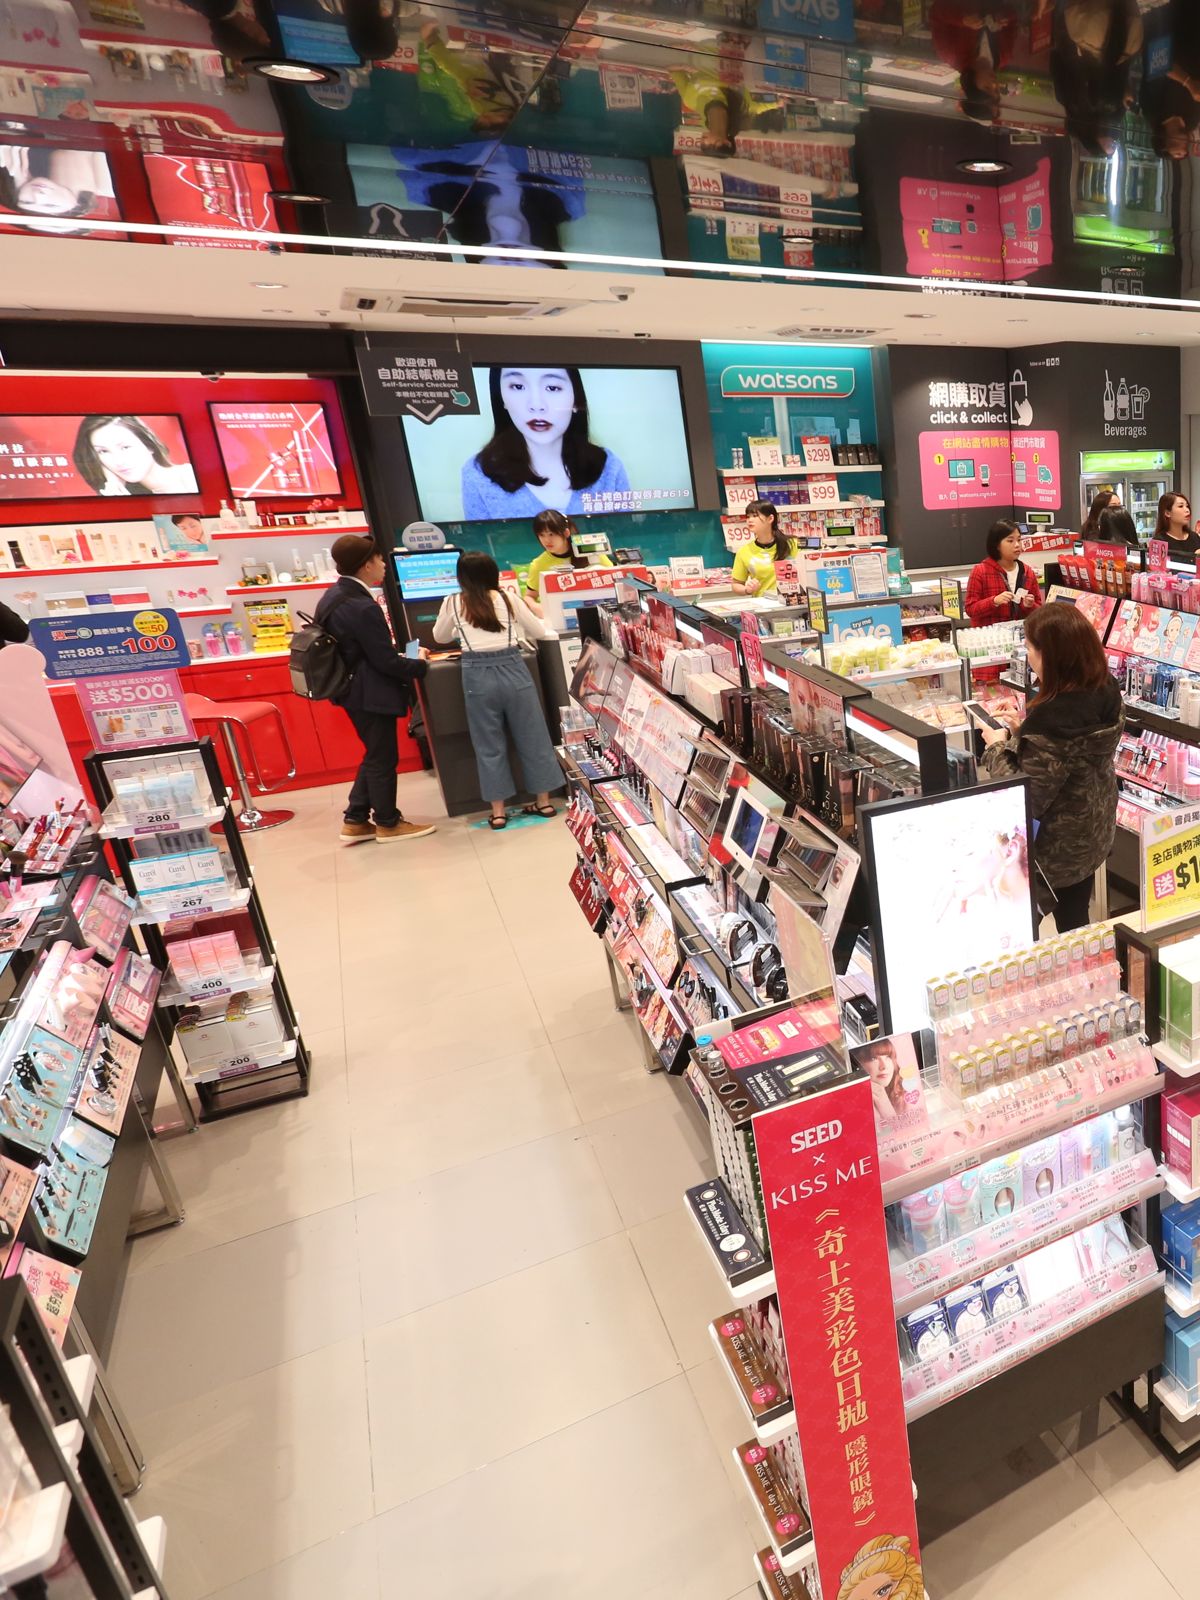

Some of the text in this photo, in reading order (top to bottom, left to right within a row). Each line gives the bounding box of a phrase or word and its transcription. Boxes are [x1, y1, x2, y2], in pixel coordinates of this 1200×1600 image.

[395, 357, 438, 368] 歡迎使用
[377, 368, 460, 381] 自助結帳機台
[738, 372, 838, 390] watsons
[928, 381, 1007, 408] 網購取貨
[930, 410, 1008, 425] click & collect
[1104, 423, 1147, 438] Beverages
[806, 447, 831, 462] $299
[728, 487, 756, 503] $149
[811, 484, 837, 500] $99
[727, 526, 751, 541] $99
[852, 617, 872, 629] try me
[76, 646, 105, 658] 888
[122, 634, 177, 654] 100
[147, 814, 170, 823] 280
[182, 898, 203, 907] 267
[201, 980, 222, 989] 400
[230, 1057, 250, 1066] 200
[790, 1119, 843, 1154] SEED
[771, 1155, 873, 1210] KISS ME
